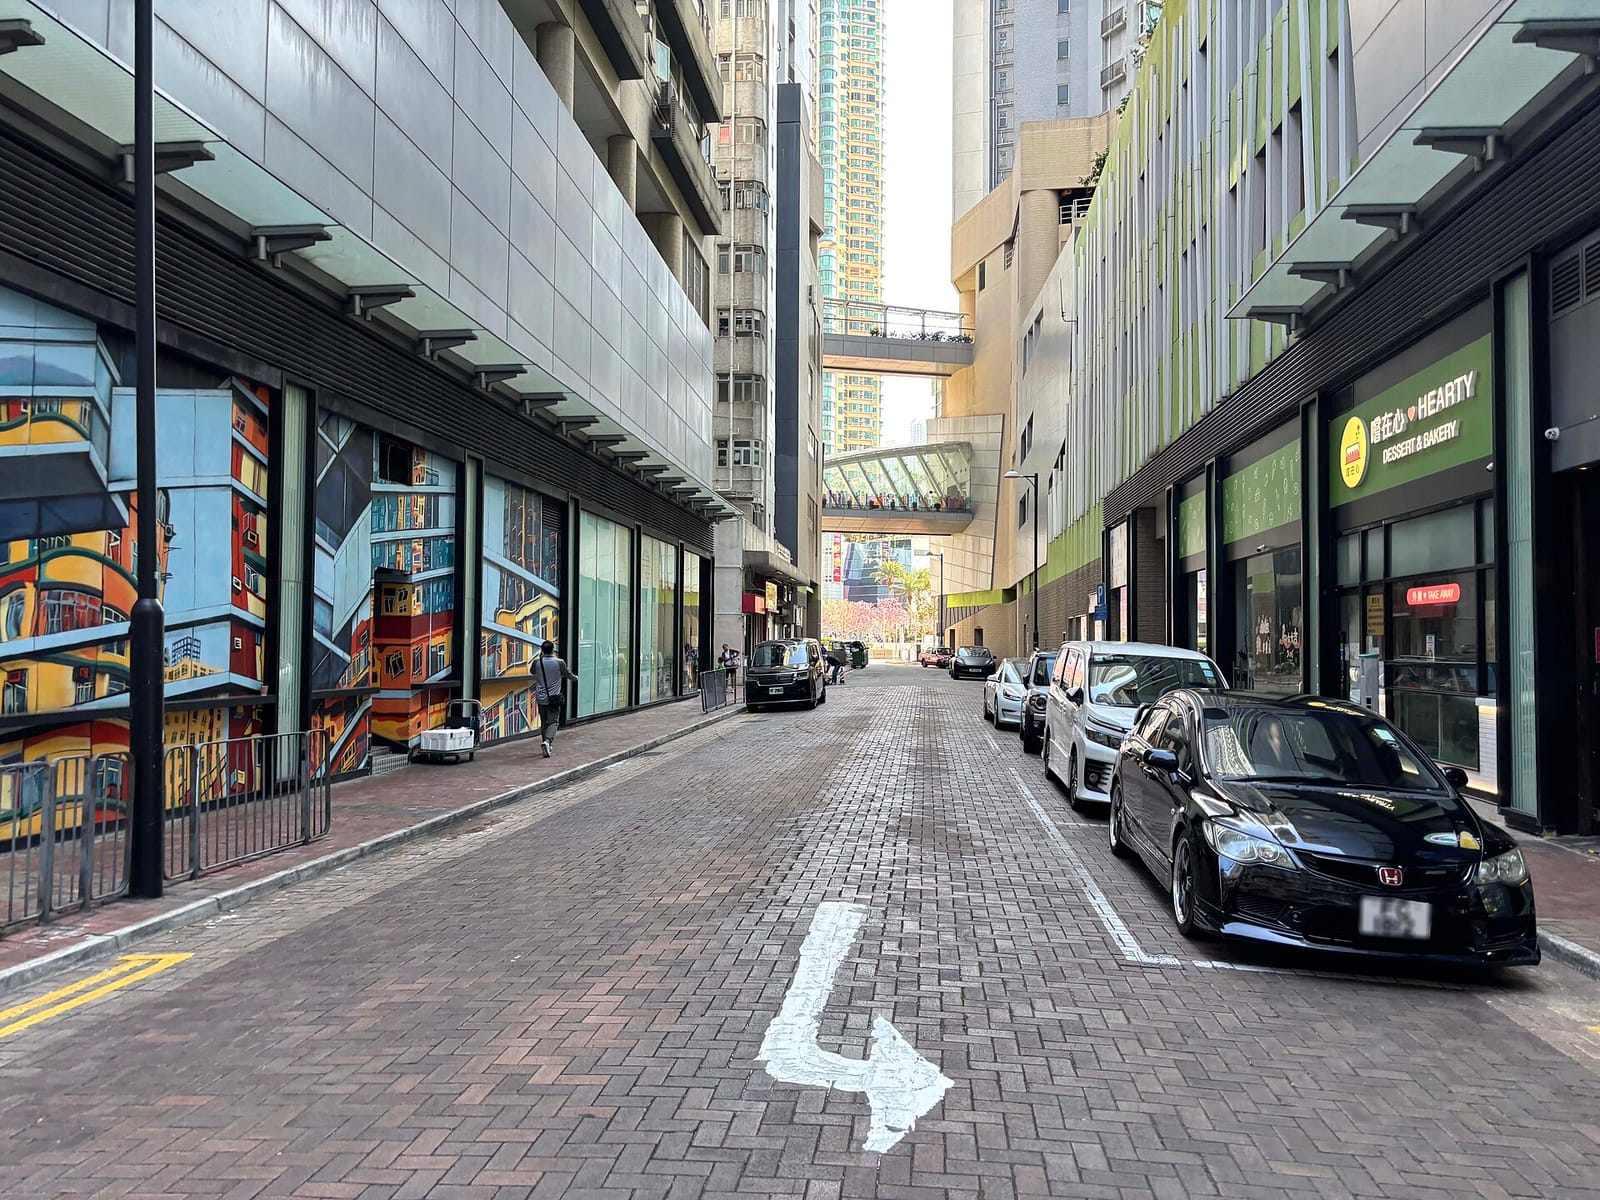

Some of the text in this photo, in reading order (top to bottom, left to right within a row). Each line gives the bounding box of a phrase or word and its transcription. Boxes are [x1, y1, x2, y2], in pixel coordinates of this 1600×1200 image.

[1418, 370, 1474, 420] HEARTY
[1383, 437, 1416, 464] DESSERT
[1423, 420, 1457, 448] BAKERY
[1428, 590, 1440, 600] TAKE
[1440, 588, 1454, 598] AWAY
